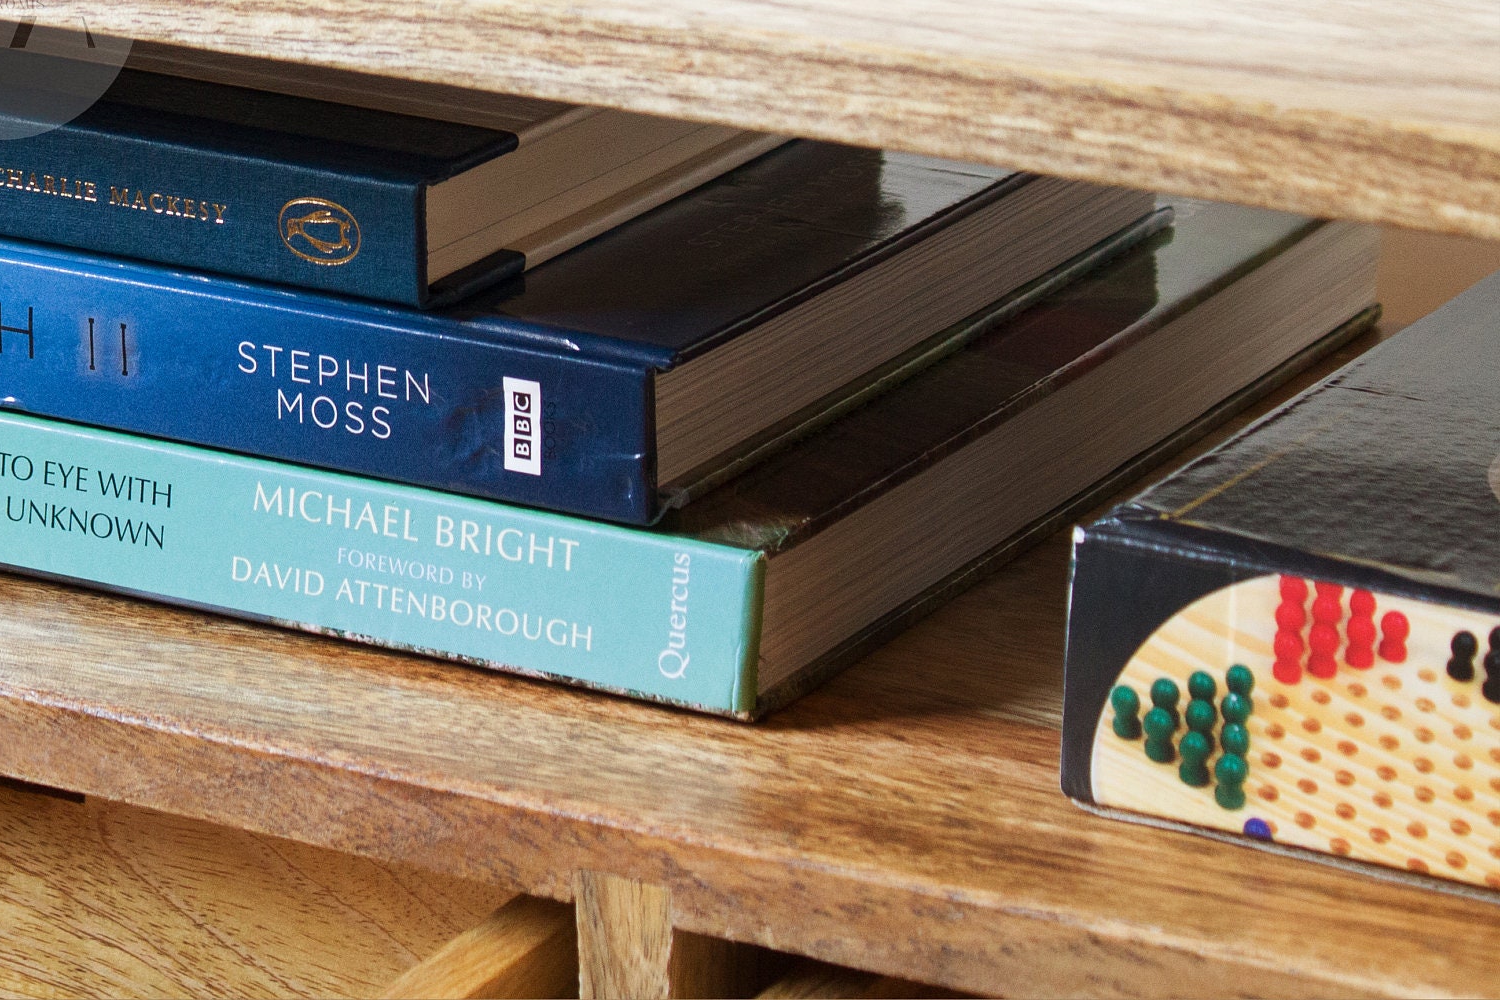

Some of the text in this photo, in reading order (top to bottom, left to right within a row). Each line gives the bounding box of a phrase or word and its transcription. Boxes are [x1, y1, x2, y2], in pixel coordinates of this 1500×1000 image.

[110, 185, 227, 225] MACKESY
[88, 317, 129, 376] II
[237, 340, 430, 404] STEPHEN
[277, 389, 392, 439] MOSS
[513, 391, 532, 461] BBC
[44, 459, 89, 493] EYE
[99, 469, 173, 509] WITH
[6, 498, 166, 550] UNKNOWN
[252, 481, 580, 571] MICHAEL BRIGHT
[337, 546, 487, 592] FOREWORD BY
[231, 555, 593, 652] DAVID ATTENBOROUGH
[658, 552, 691, 680] Quercus
